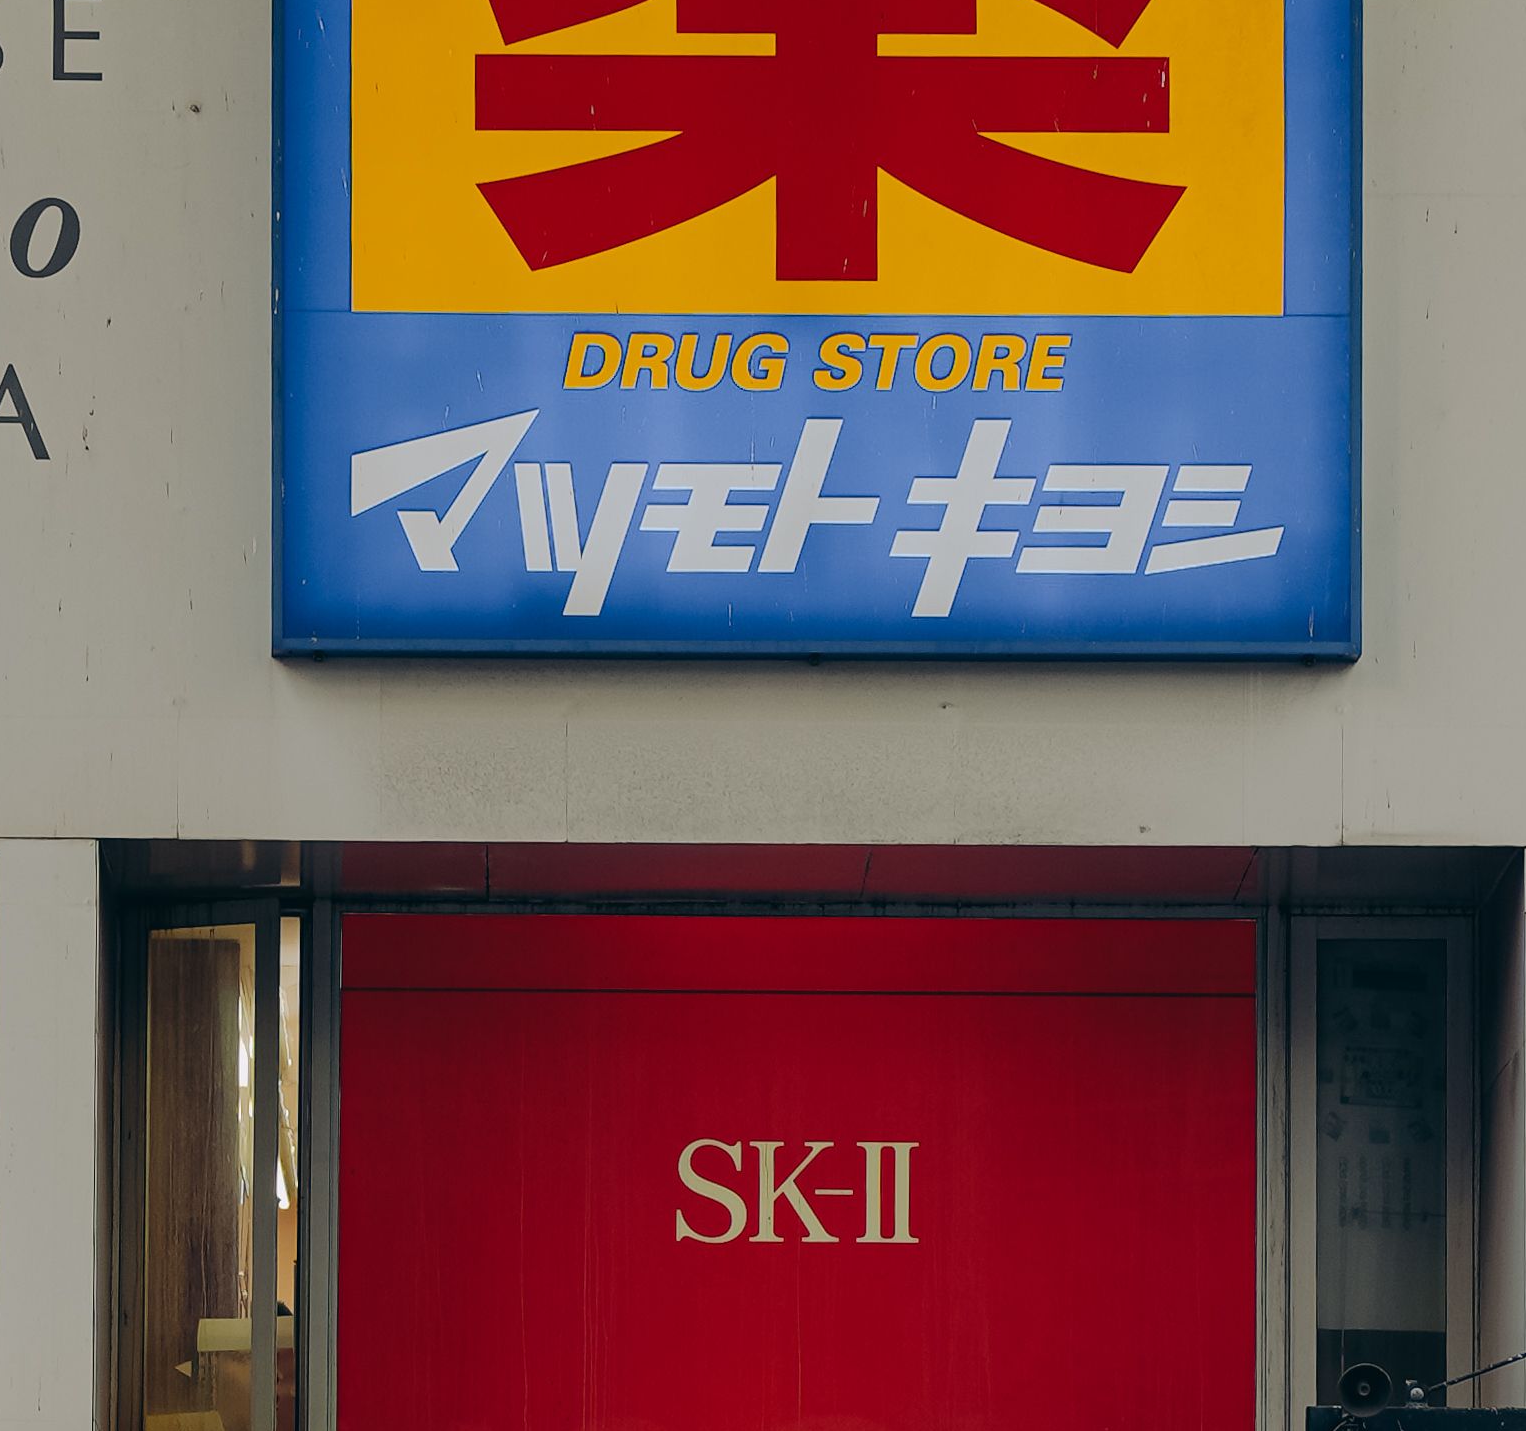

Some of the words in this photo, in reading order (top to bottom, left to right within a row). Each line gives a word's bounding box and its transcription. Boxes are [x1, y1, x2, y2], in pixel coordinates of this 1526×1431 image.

[563, 332, 793, 393] DRUG
[812, 332, 1073, 393] STORE
[351, 407, 1284, 617] マツモトキヨシ
[676, 1138, 920, 1244] SK-II
